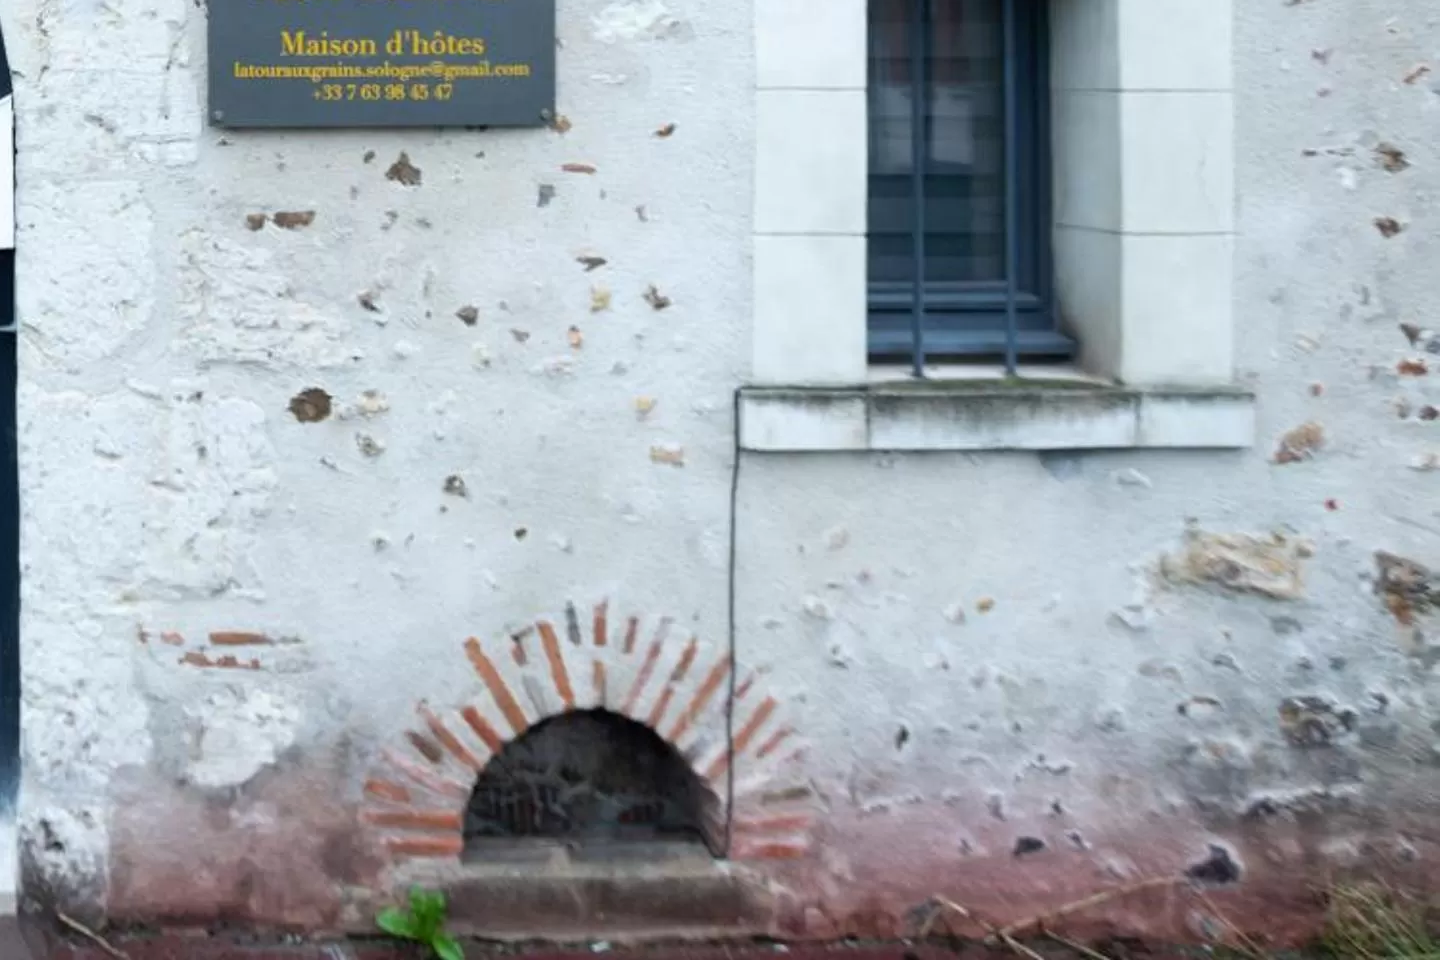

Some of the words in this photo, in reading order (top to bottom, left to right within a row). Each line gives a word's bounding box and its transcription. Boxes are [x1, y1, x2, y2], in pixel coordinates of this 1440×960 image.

[280, 30, 377, 56] Maison
[386, 29, 485, 56] d'hôtes
[234, 60, 530, 81] latourauxgrains.sologne@gmail.com
[312, 83, 343, 101] +33
[347, 84, 356, 101] 7
[361, 83, 382, 101] 63
